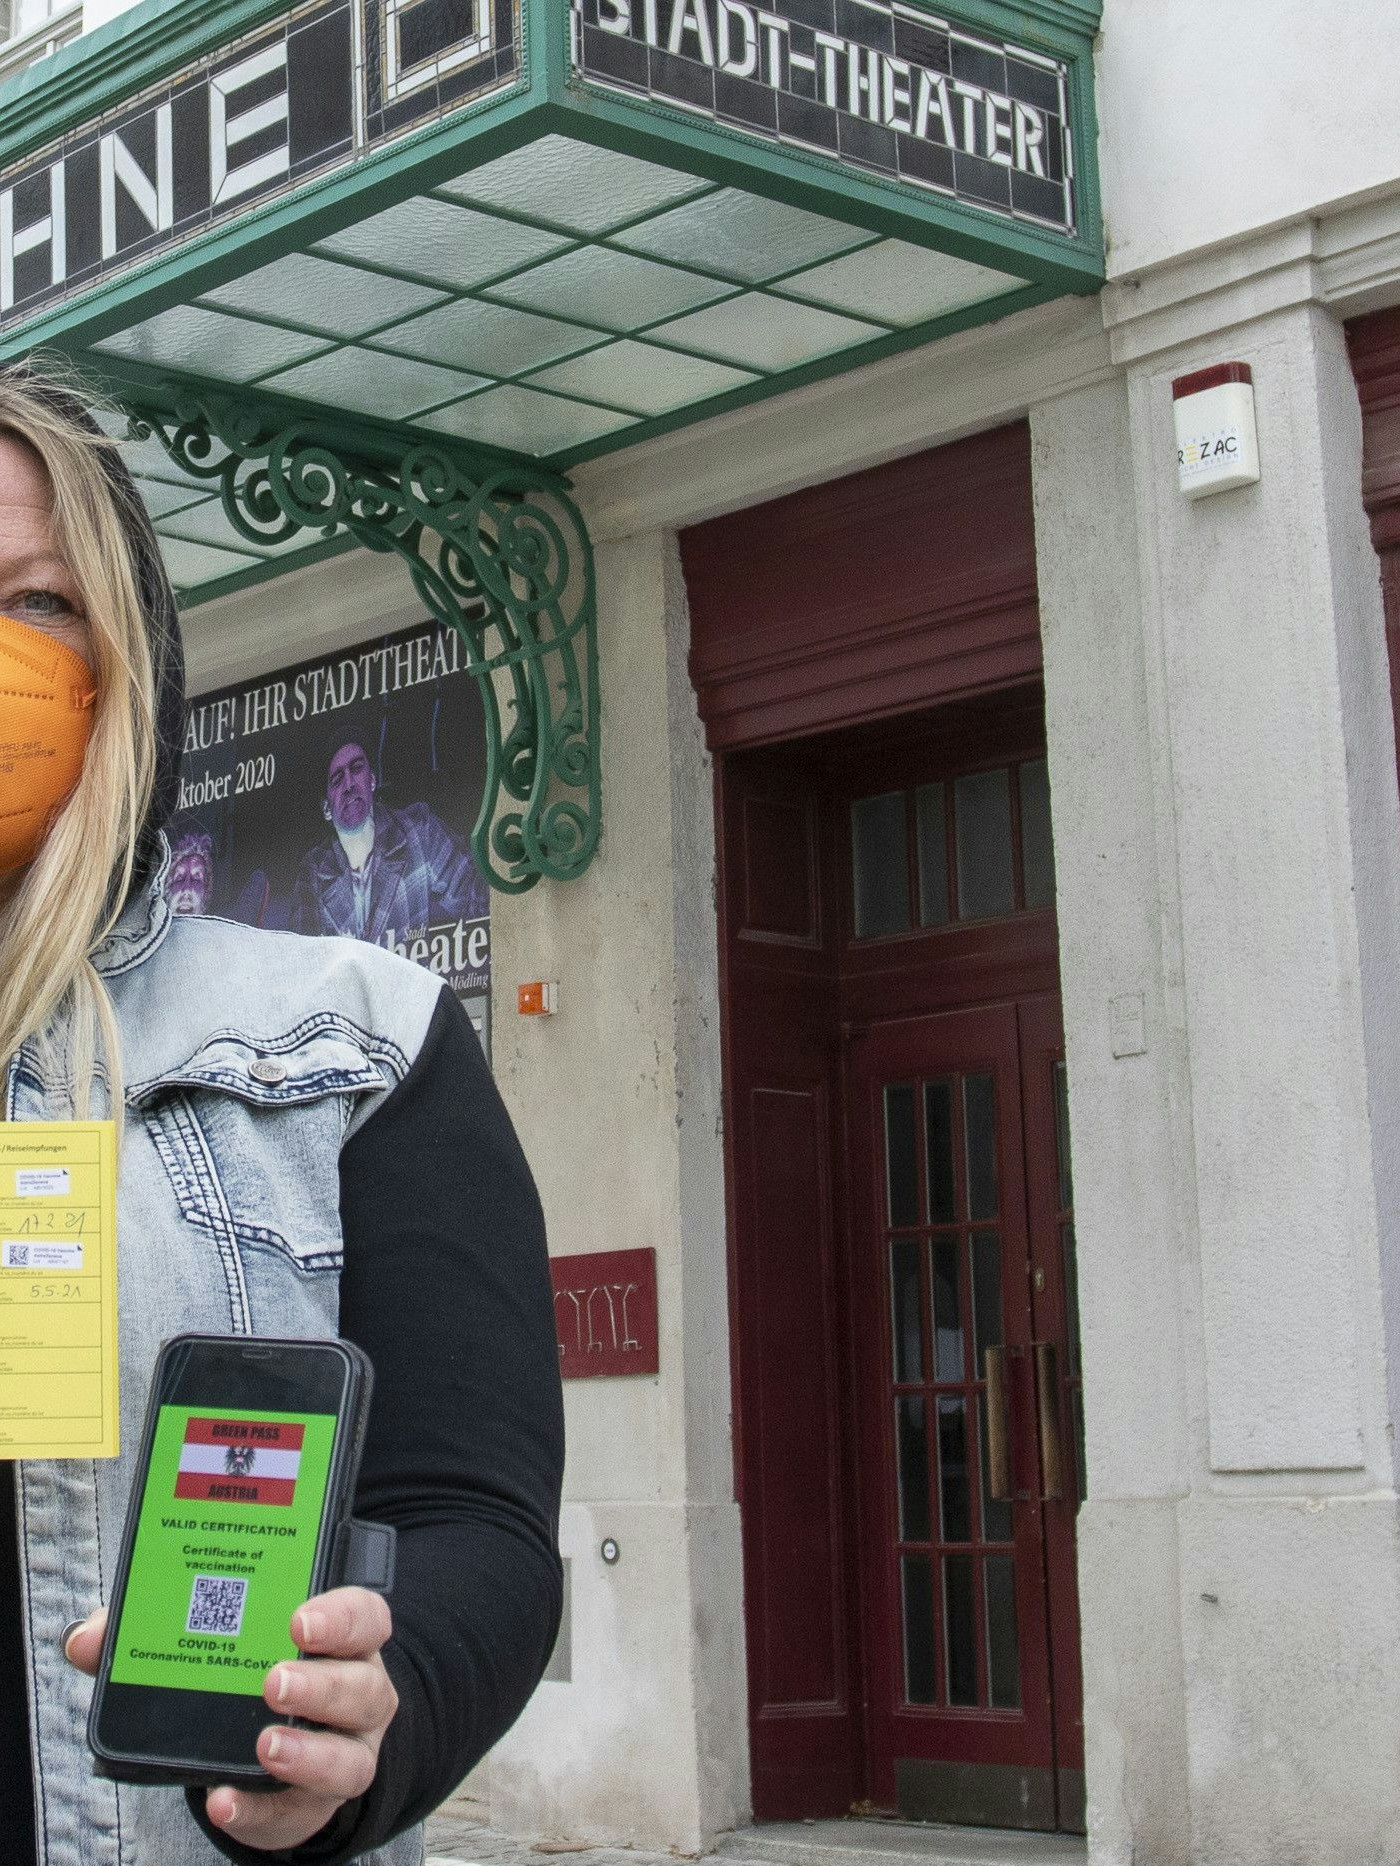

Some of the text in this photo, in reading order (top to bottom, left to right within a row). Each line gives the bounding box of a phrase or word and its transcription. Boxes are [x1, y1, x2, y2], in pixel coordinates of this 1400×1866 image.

[182, 626, 478, 754] AUF! IHR STADTTHEAT
[175, 753, 276, 812] ktober 2020
[403, 922, 427, 942] Stadt
[375, 918, 491, 976] heate
[6, 1144, 68, 1153] Reiseimpfungen
[211, 1424, 281, 1441] GREEN PASS
[208, 1484, 259, 1500] AUSTRIA
[161, 1518, 297, 1537] VALID CERTIFICATION
[182, 1545, 264, 1561] Certificate of
[185, 1561, 256, 1574] vaccination
[178, 1638, 236, 1652] COVID-19
[130, 1649, 279, 1671] Coronavirus SARS-CoV-
